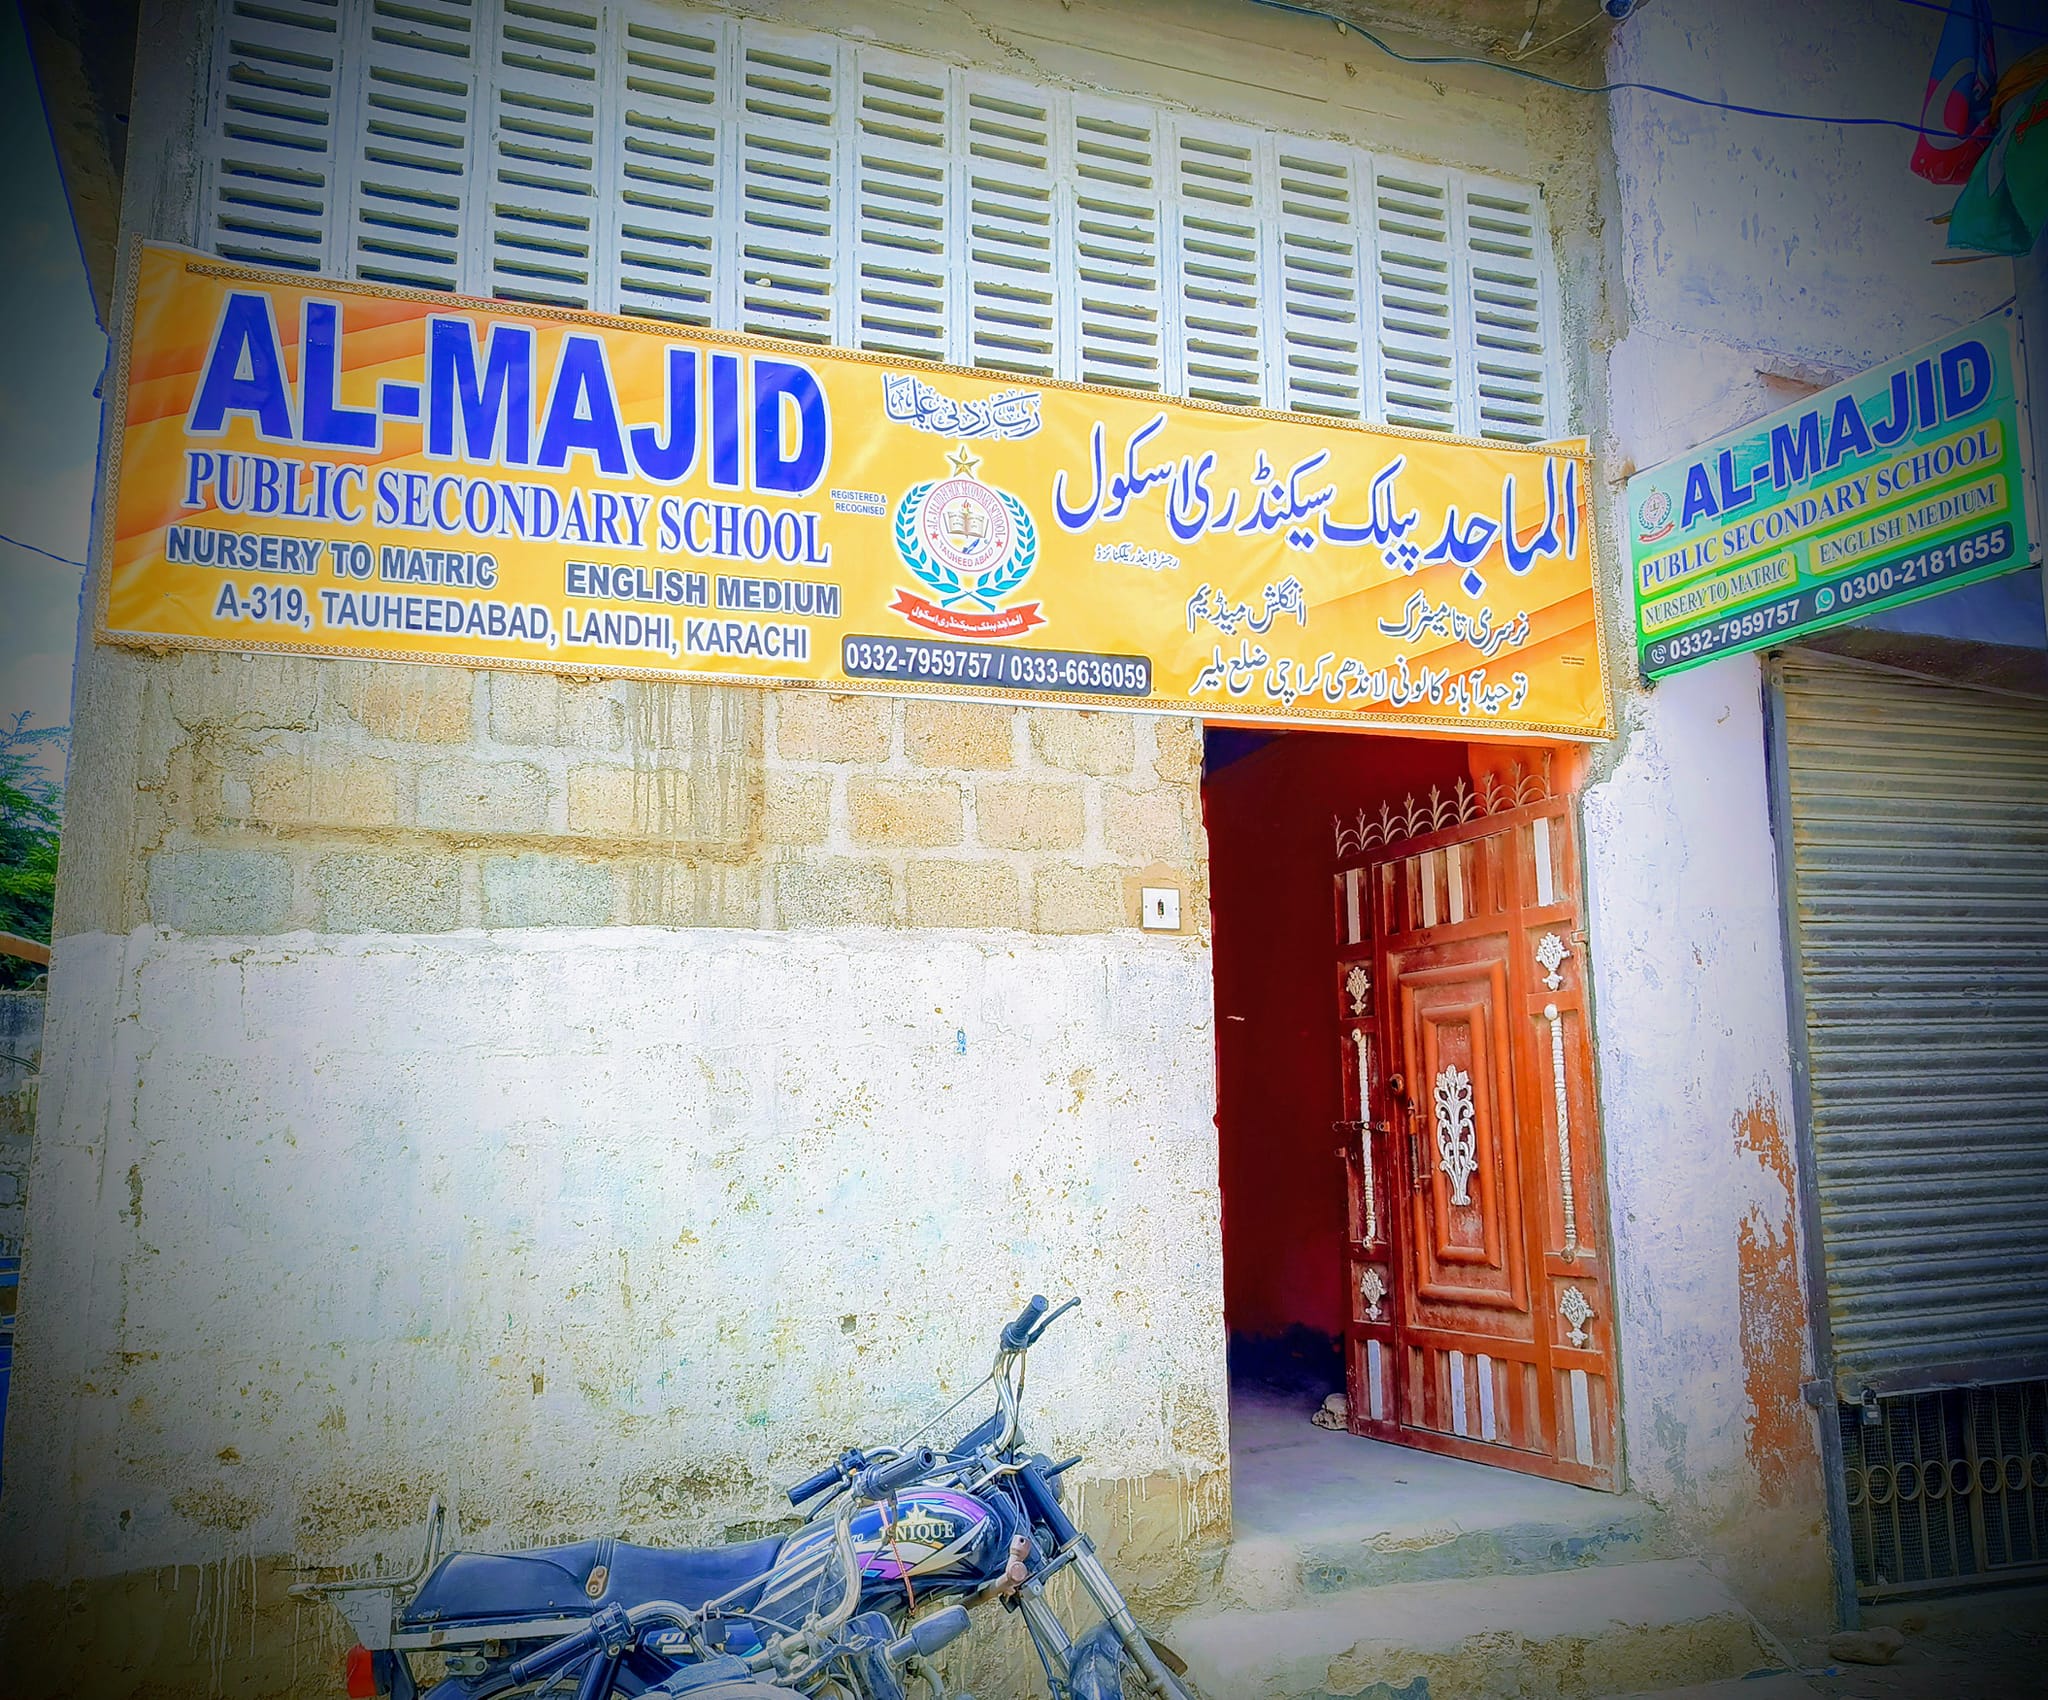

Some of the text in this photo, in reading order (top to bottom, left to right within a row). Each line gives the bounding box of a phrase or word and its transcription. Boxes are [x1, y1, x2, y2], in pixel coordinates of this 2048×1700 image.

[190, 292, 830, 490] AL-MAJID
[1680, 341, 1992, 531] AL-MAJID
[185, 451, 831, 565] PUBLIC SECONDARY SCHOOL
[831, 490, 886, 503] REGISTERED &
[835, 503, 885, 515] RECOGNISED
[990, 504, 1006, 538] SCHOOL
[1056, 415, 1576, 595] الماجد پبلک سیکنڈری اسکول
[1641, 428, 1998, 588] PUBLIC SECONDARY SCHOOL
[1819, 484, 1998, 563] ENGLISH MEDIUM
[166, 527, 499, 589] NURSERY TO MATRIC
[938, 540, 994, 567] TAUHEED ABAD
[566, 561, 839, 618] ENGLISH MEDIUM
[1645, 557, 1791, 627] NURSERY TO MATRIC
[1670, 528, 2007, 661] 0332-7959757 0300-2181655
[216, 584, 808, 660] A-319, TAUHEEDABAD, LANDHI, KARACHI
[1468, 609, 1530, 657] نرسری
[846, 642, 1147, 690] 0332-7959757 / 0333-6636059
[1190, 647, 1225, 695] ملیر
[1229, 641, 1268, 694] ضلع
[1267, 654, 1333, 704] کراچی
